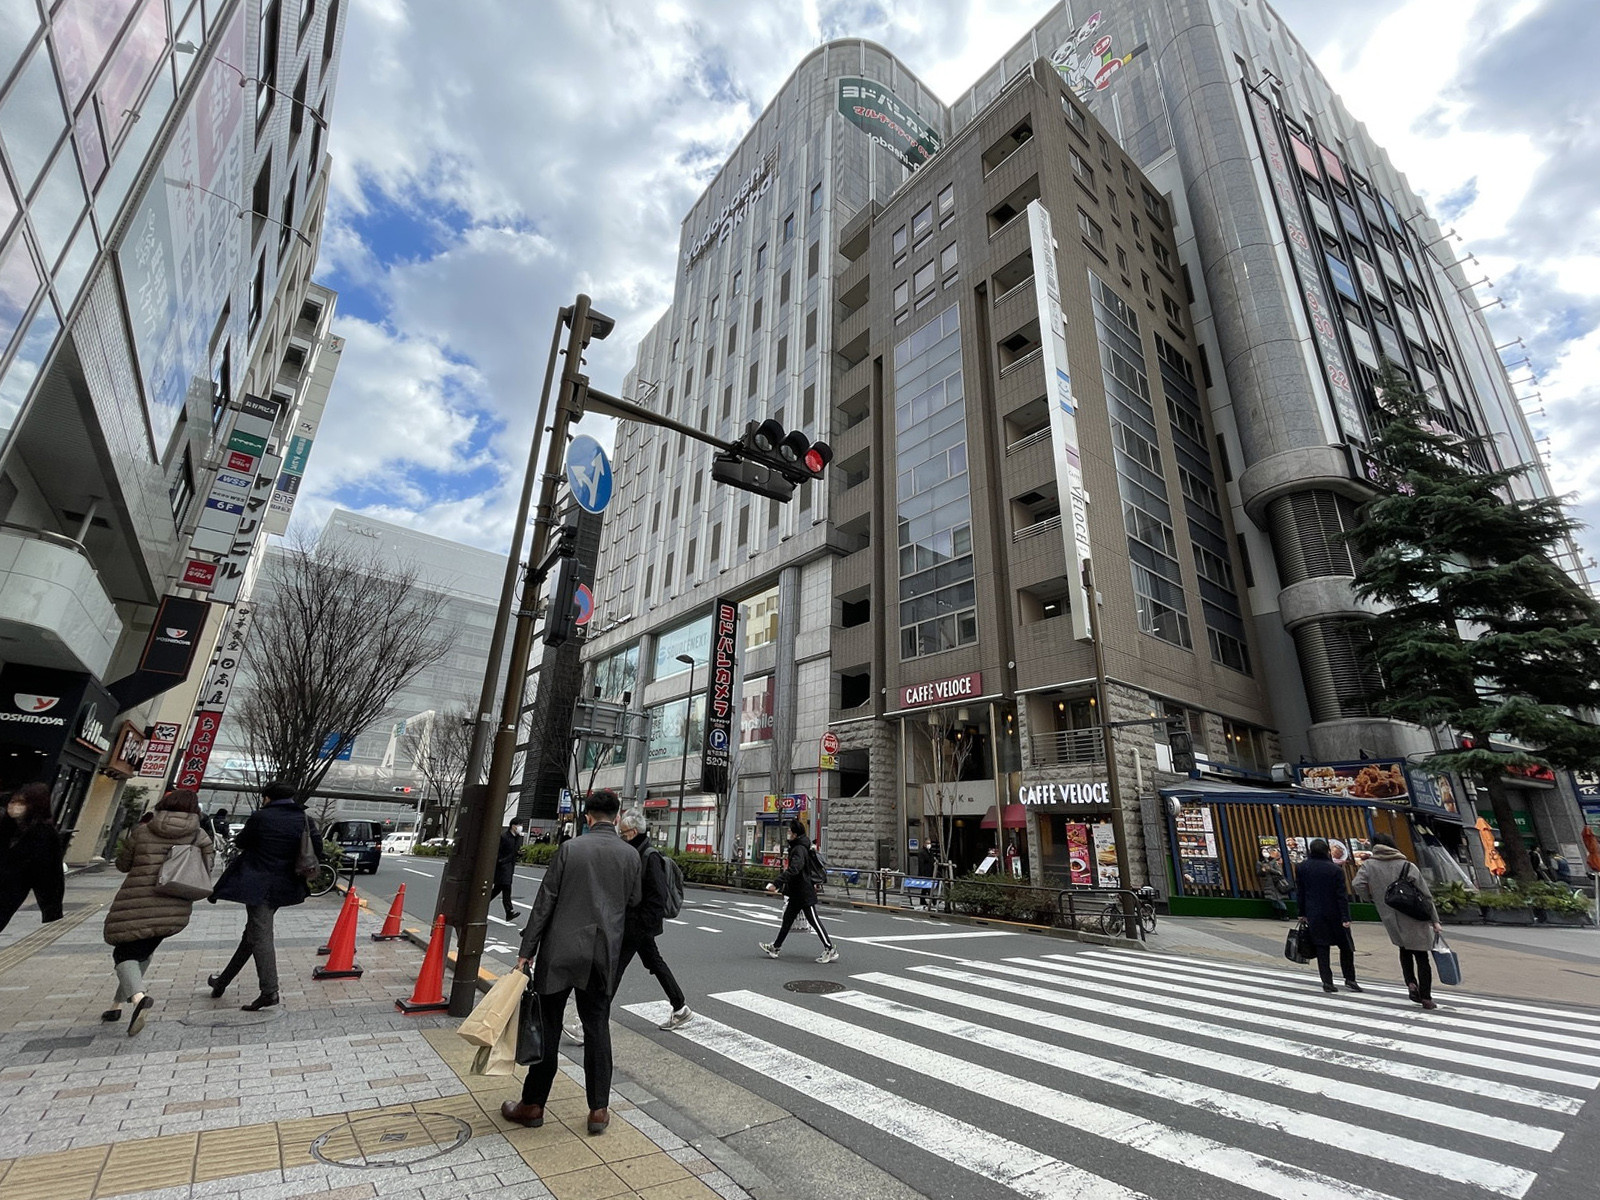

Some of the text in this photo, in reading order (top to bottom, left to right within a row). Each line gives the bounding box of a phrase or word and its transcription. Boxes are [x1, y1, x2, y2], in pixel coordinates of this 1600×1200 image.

[842, 86, 940, 152] ヨドバシカメラ
[223, 475, 247, 487] WSS
[216, 501, 234, 511] 6F
[273, 492, 295, 505] ena
[713, 604, 735, 719] ヨドバシカメラ
[206, 658, 236, 705] 日高屋
[906, 677, 972, 704] CAFFÈ VELOCE
[0, 712, 64, 726] OSHINOYA
[182, 717, 214, 786] ちょい飲み
[648, 747, 667, 758] ocomo
[1019, 782, 1110, 805] CAFFÈ VELOCE
[1579, 785, 1599, 795] TX
